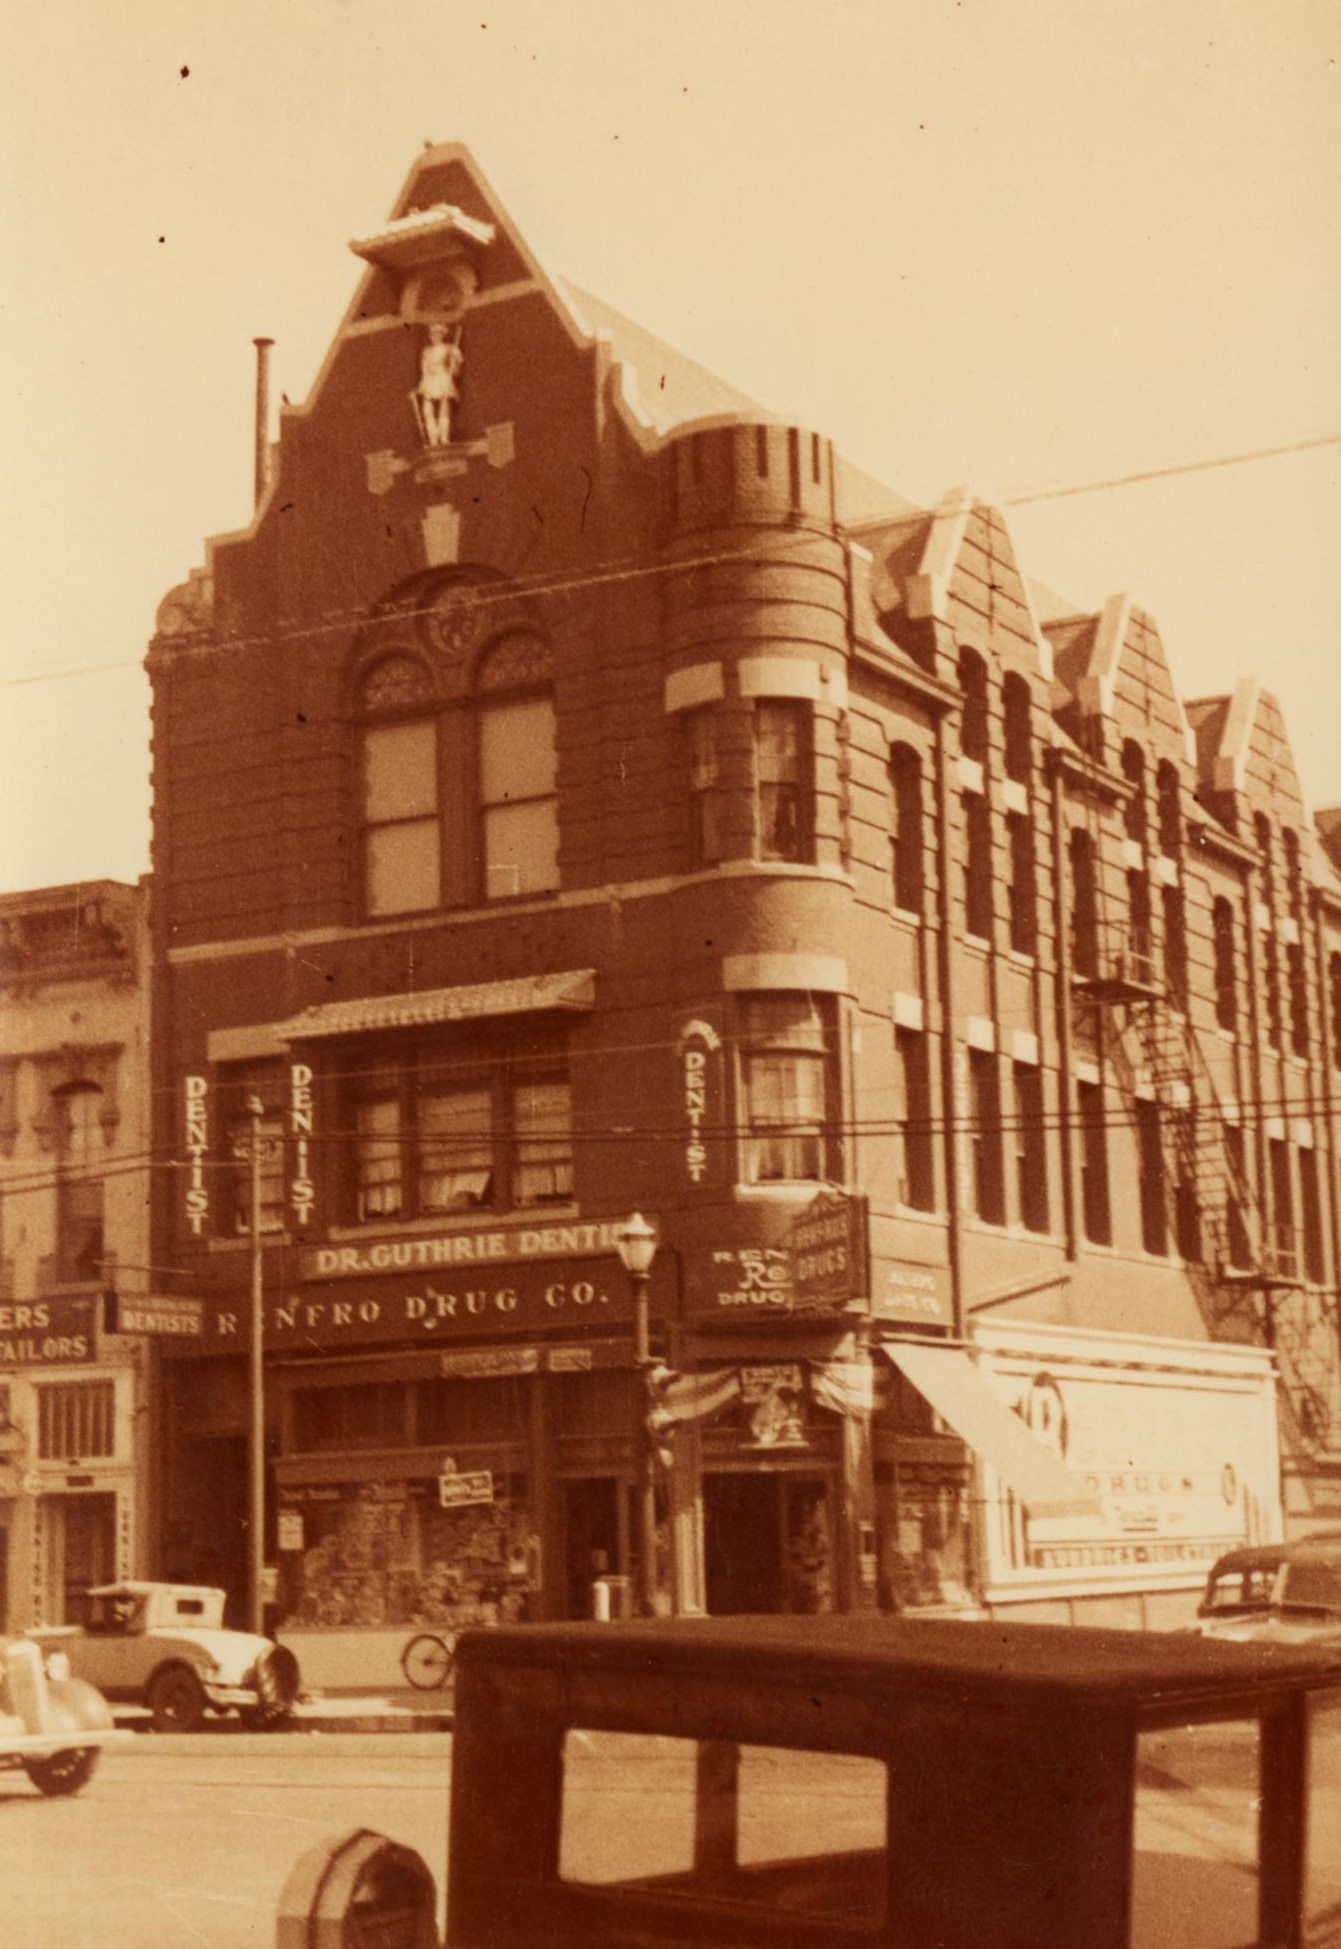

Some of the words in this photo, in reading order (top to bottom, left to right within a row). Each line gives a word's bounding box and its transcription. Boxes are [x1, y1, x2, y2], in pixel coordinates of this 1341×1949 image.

[185, 1075, 208, 1235] DENTIST
[290, 1064, 315, 1225] DENTIST
[685, 1052, 706, 1182] DENTIST
[519, 1221, 625, 1255] DENTIS
[121, 1311, 200, 1334] DENTISTS
[217, 1299, 381, 1334] RNFRO
[405, 1289, 519, 1319] DRUG
[545, 1281, 609, 1307] CO.
